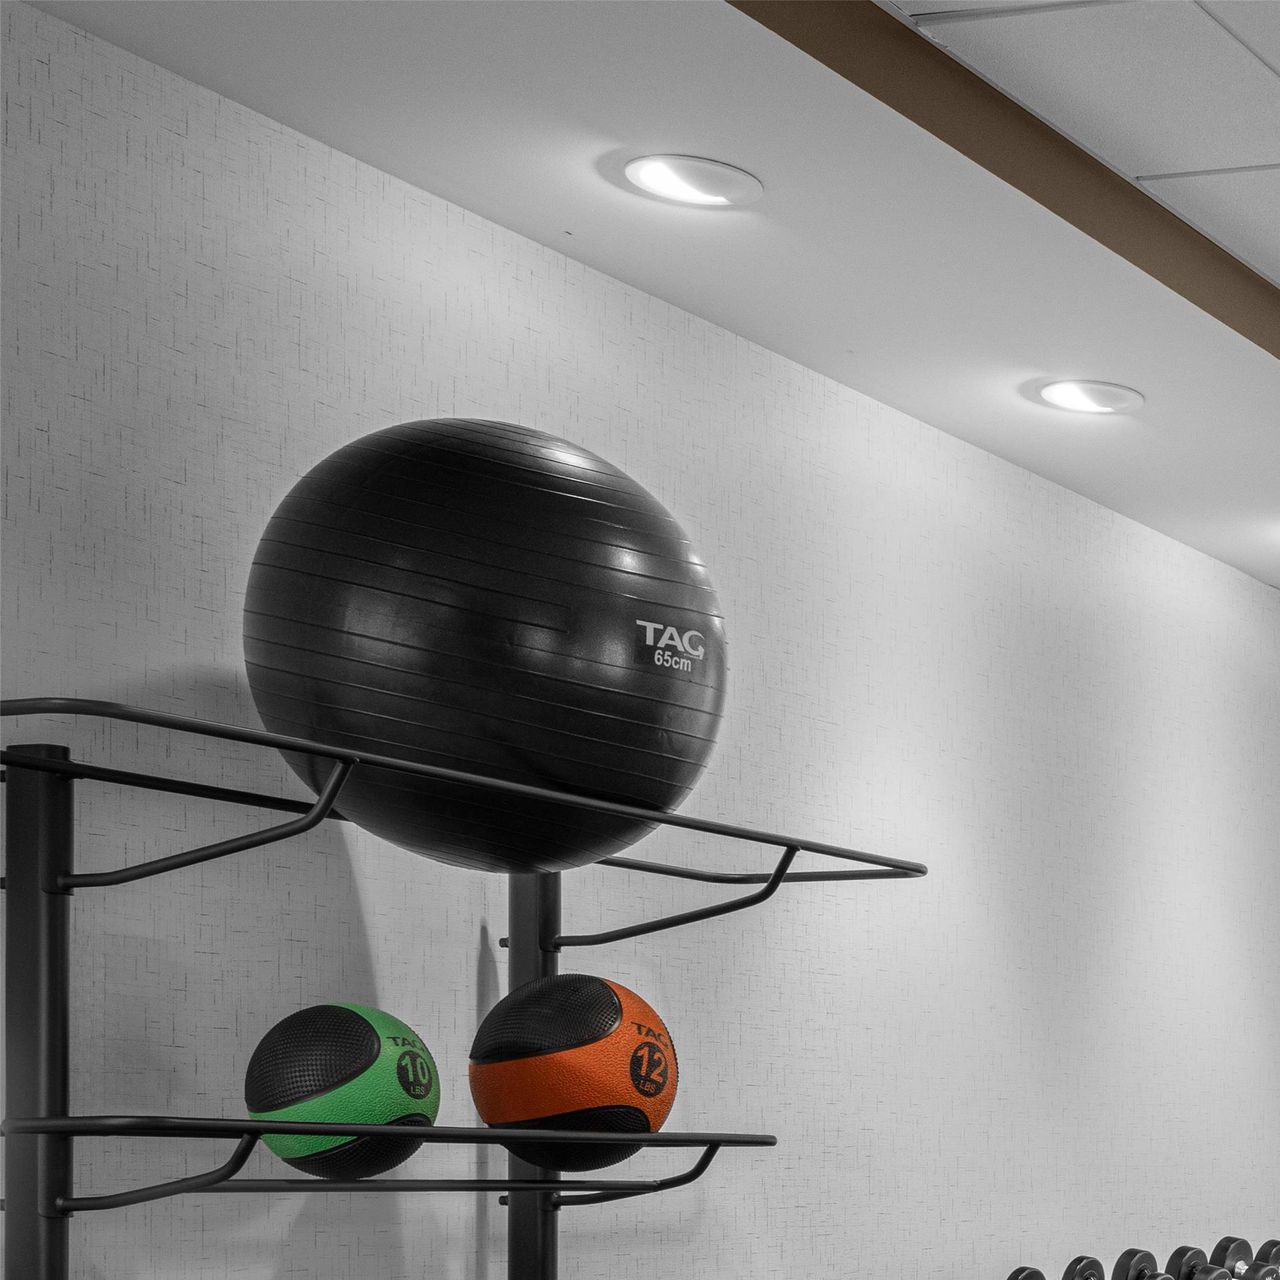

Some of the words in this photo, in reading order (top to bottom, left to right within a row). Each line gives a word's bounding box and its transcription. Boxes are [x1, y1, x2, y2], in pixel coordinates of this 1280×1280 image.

[636, 619, 705, 660] TAG
[654, 649, 692, 672] 65cm
[400, 1055, 430, 1085] 10
[637, 1046, 665, 1083] 12
